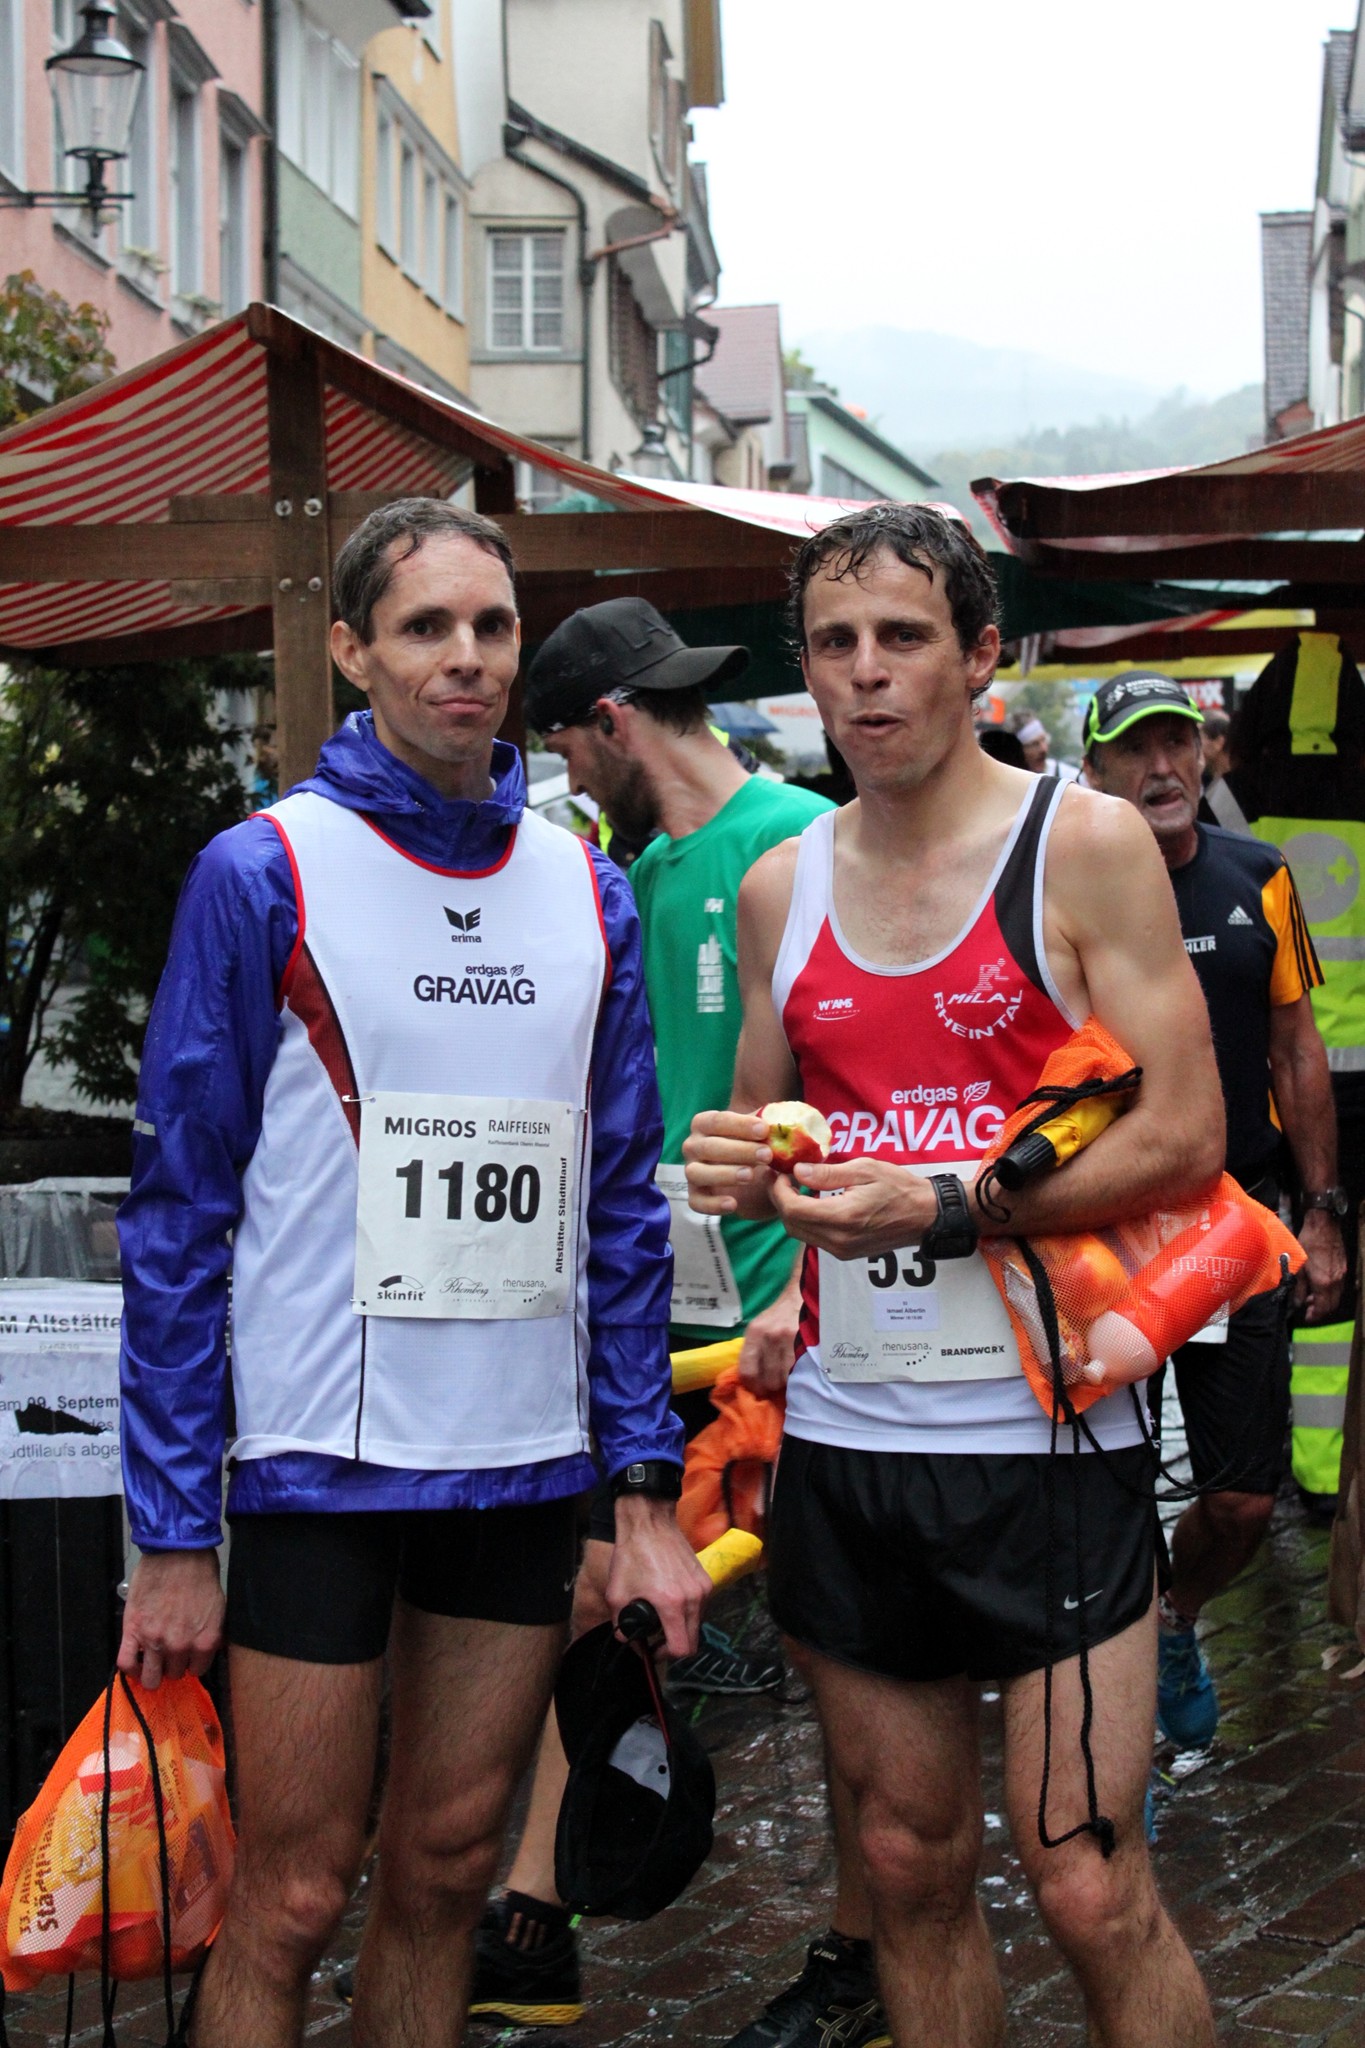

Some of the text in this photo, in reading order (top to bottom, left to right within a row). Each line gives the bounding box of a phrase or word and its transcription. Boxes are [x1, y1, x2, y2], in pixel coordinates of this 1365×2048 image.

[451, 933, 482, 944] erima
[465, 964, 507, 977] erdgas
[413, 974, 536, 1005] GRAVAG
[933, 989, 1023, 1040] RHEINTAL
[891, 1084, 958, 1107] erdgas
[384, 1116, 477, 1139] MIGROS
[488, 1119, 551, 1135] RAIFFEISEN
[826, 1104, 1007, 1154] GRAVAG
[396, 1159, 541, 1224] 1180
[554, 1156, 568, 1274] Altstätter Städtlilauf
[377, 1290, 424, 1301] skinfit
[439, 1277, 489, 1299] Rhomberg
[829, 1341, 869, 1363] Rhomberg
